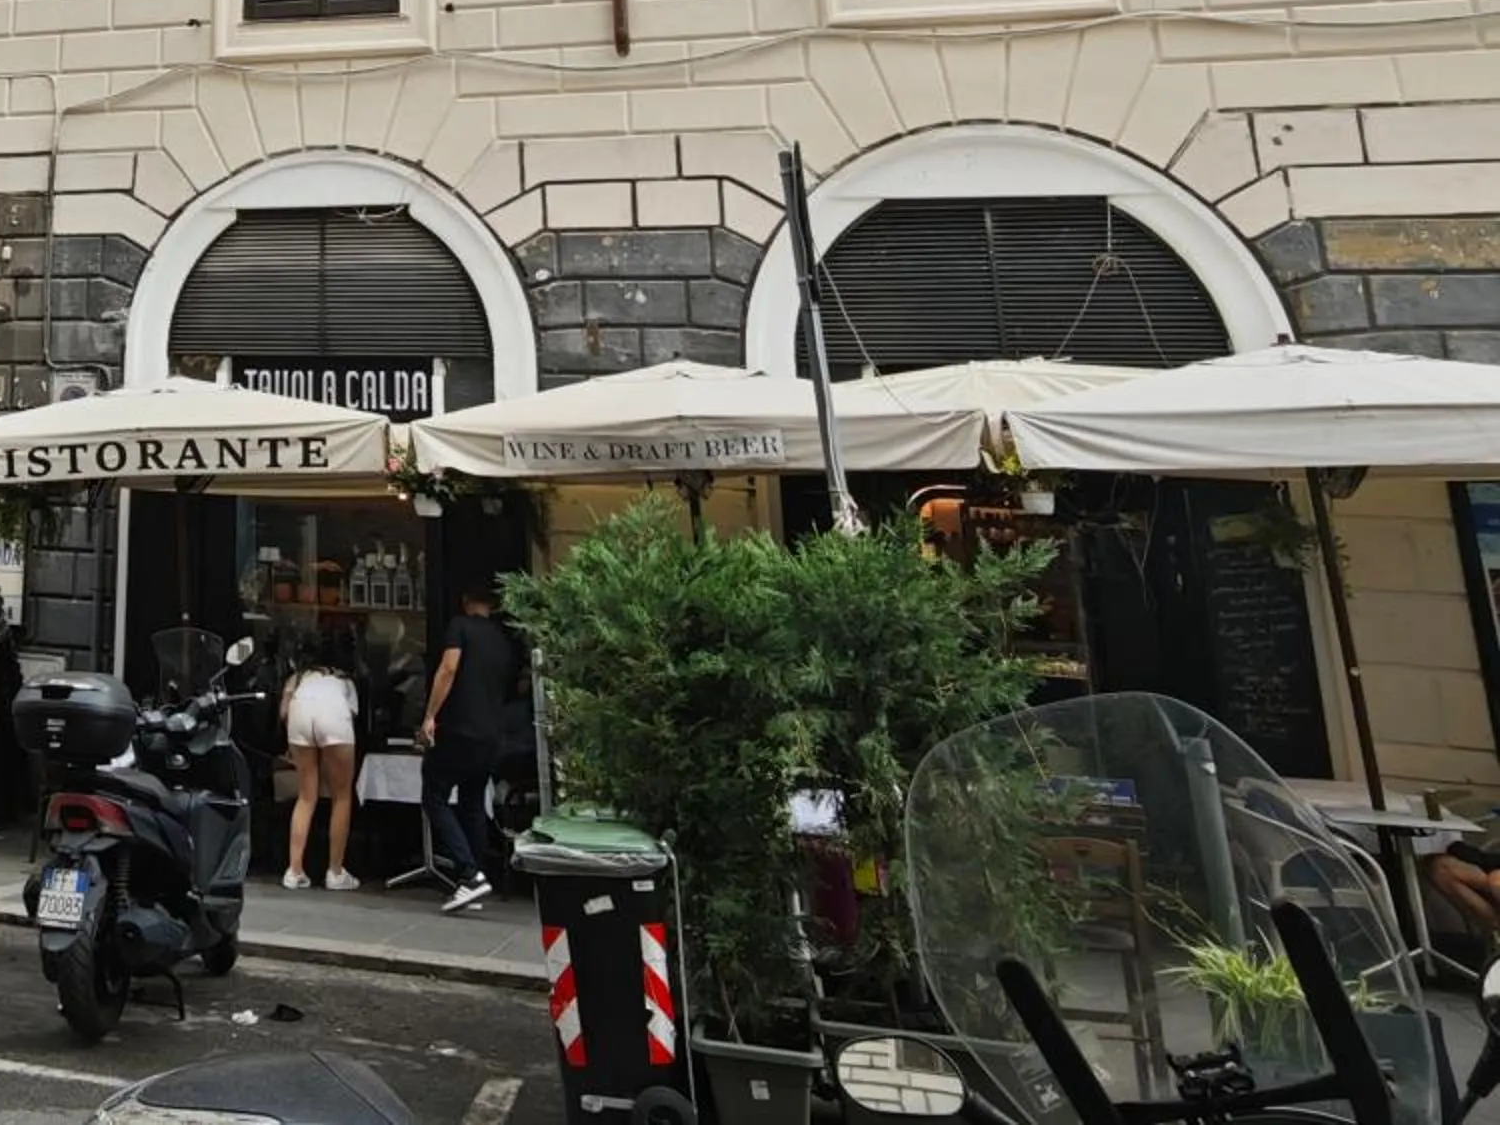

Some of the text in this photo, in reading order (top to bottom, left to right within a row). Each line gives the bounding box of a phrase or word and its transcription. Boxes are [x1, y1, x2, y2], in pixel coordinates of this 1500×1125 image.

[345, 371, 428, 412] CALDA
[507, 435, 780, 461] WINE & DRAFT BEER
